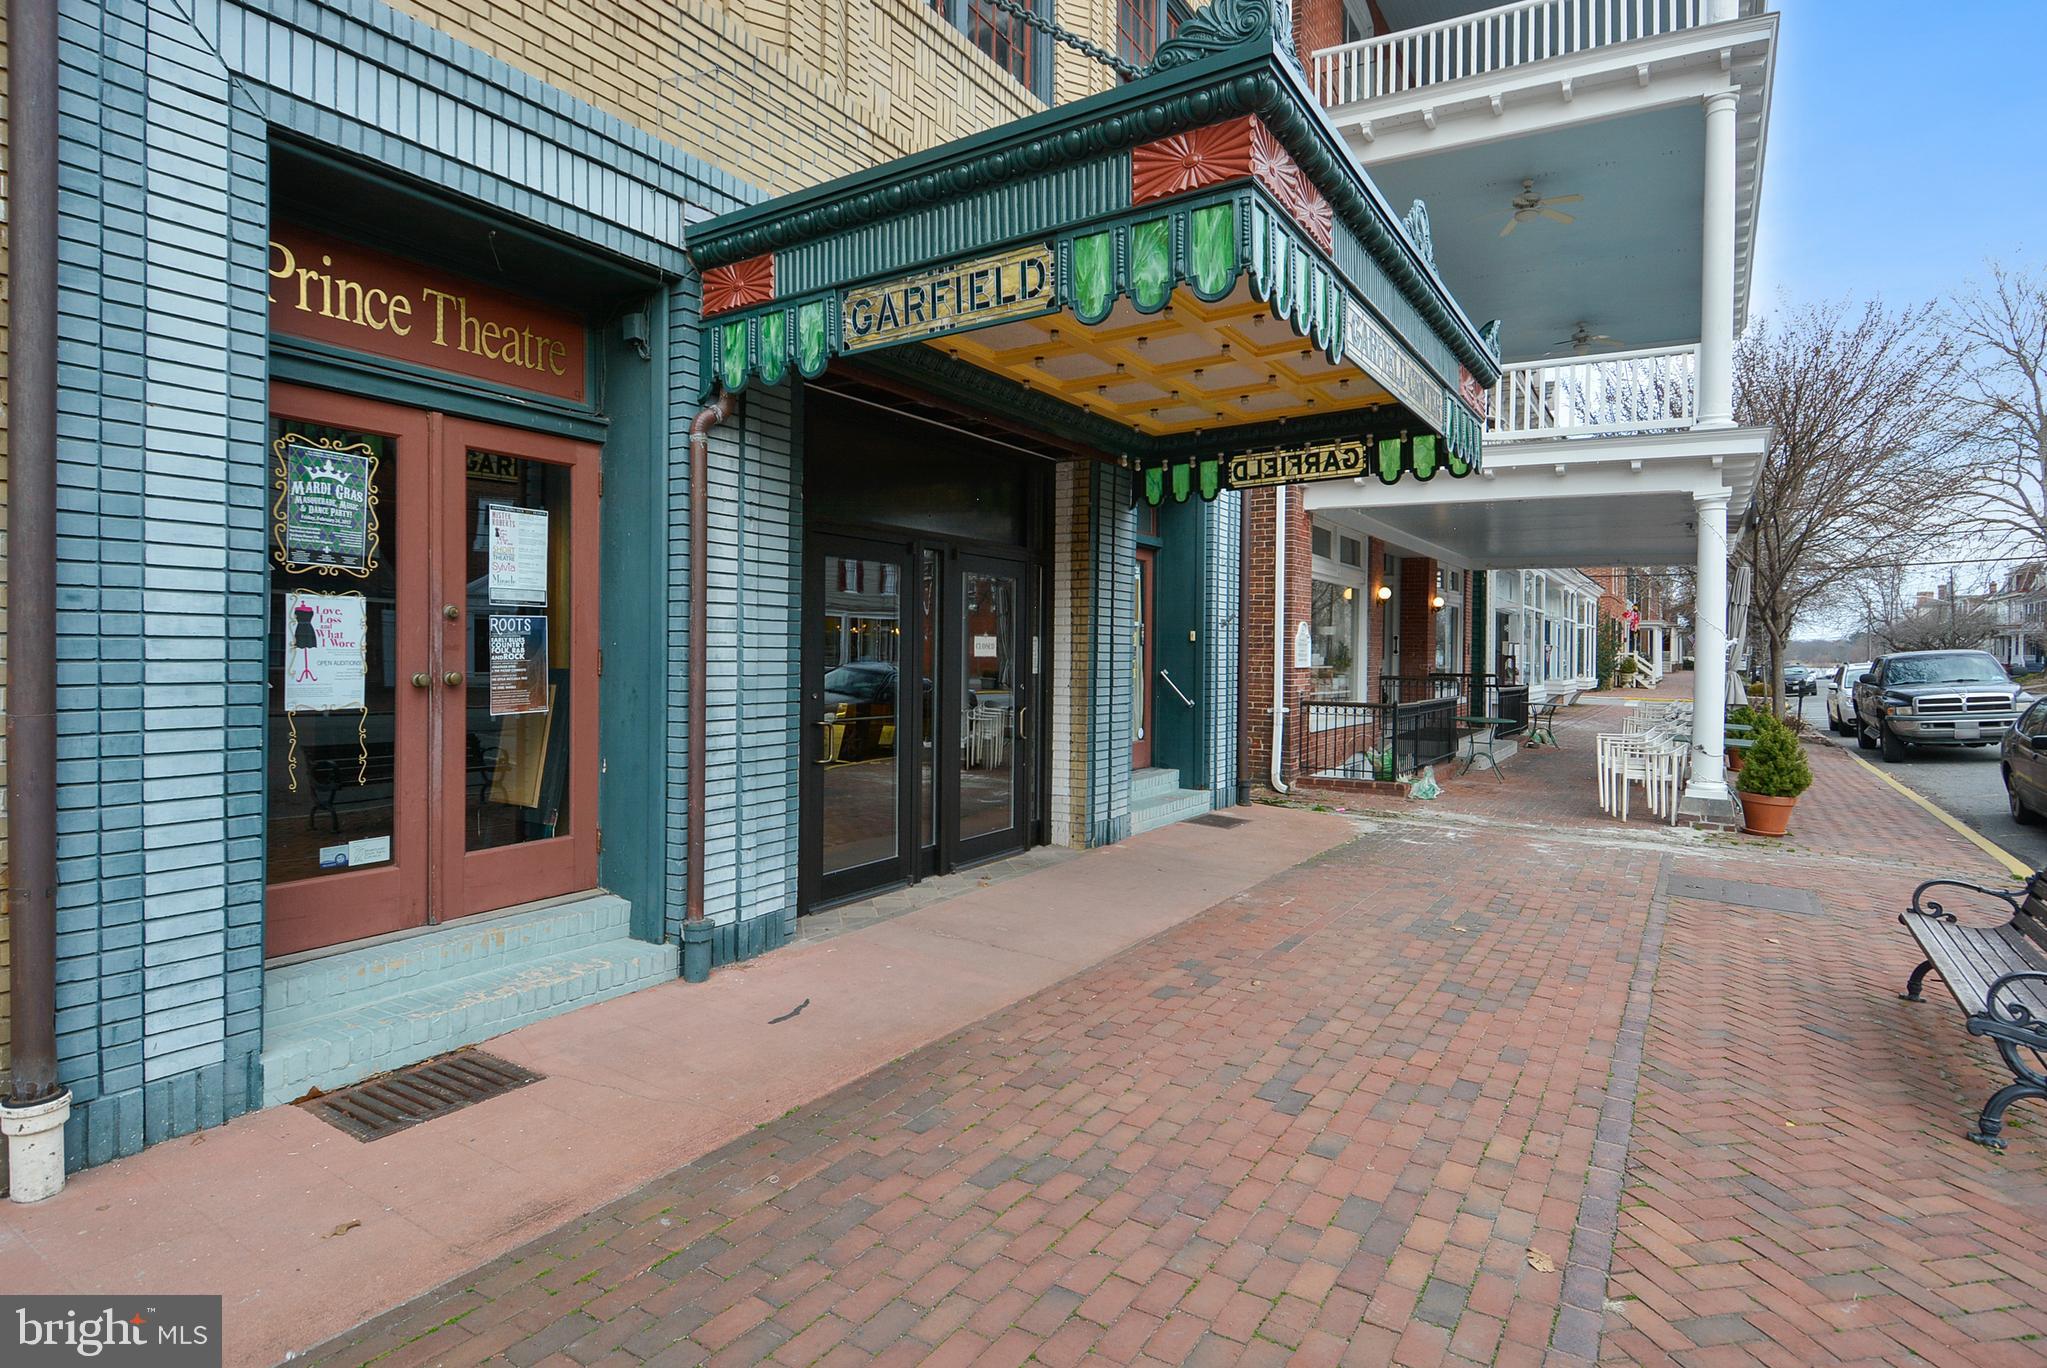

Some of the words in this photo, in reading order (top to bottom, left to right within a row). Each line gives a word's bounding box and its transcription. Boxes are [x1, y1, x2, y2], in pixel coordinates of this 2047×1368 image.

[851, 256, 1046, 336] GARFIELD
[269, 241, 412, 336] Prince
[422, 287, 567, 376] Theatre
[290, 480, 331, 495] MARDI
[335, 484, 364, 503] GRAS
[308, 505, 329, 515] DANCE
[330, 507, 353, 519] PARTY!
[320, 615, 342, 623] Loss
[490, 617, 532, 635] ROOTS
[315, 629, 344, 639] What
[321, 639, 326, 647] I
[330, 638, 356, 648] Wore
